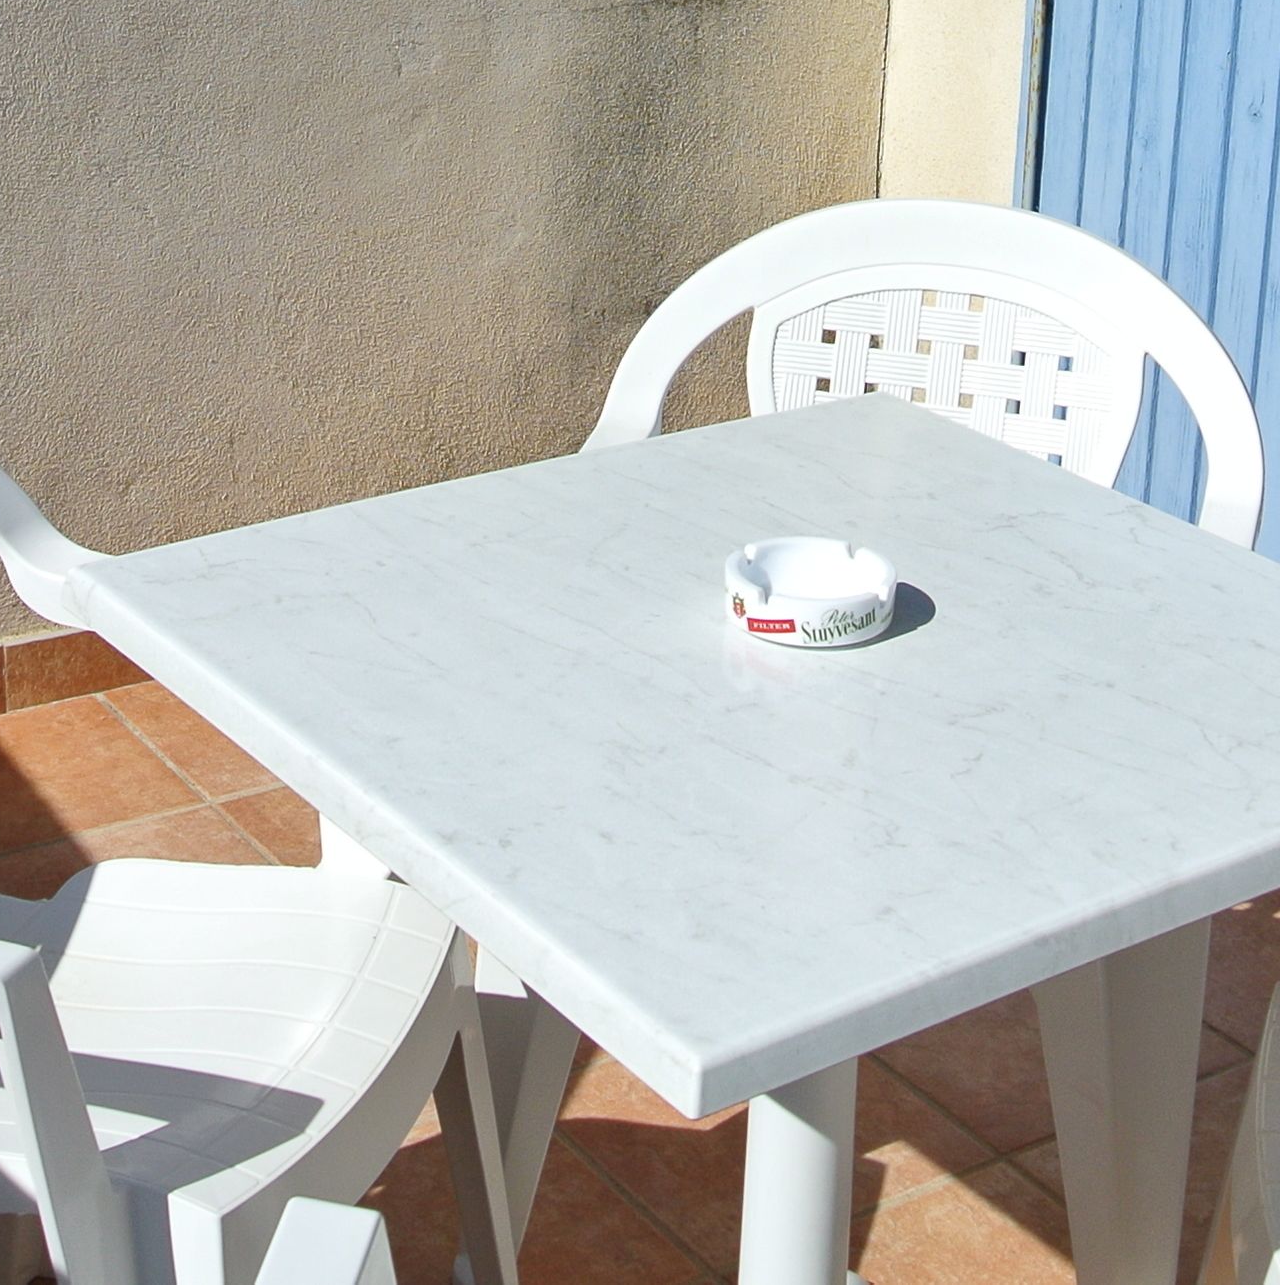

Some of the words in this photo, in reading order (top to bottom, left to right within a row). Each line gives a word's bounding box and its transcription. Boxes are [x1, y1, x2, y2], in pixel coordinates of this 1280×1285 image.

[751, 621, 791, 630] FILTER
[801, 607, 877, 645] Stuyvesant
[821, 608, 854, 627] Peter
